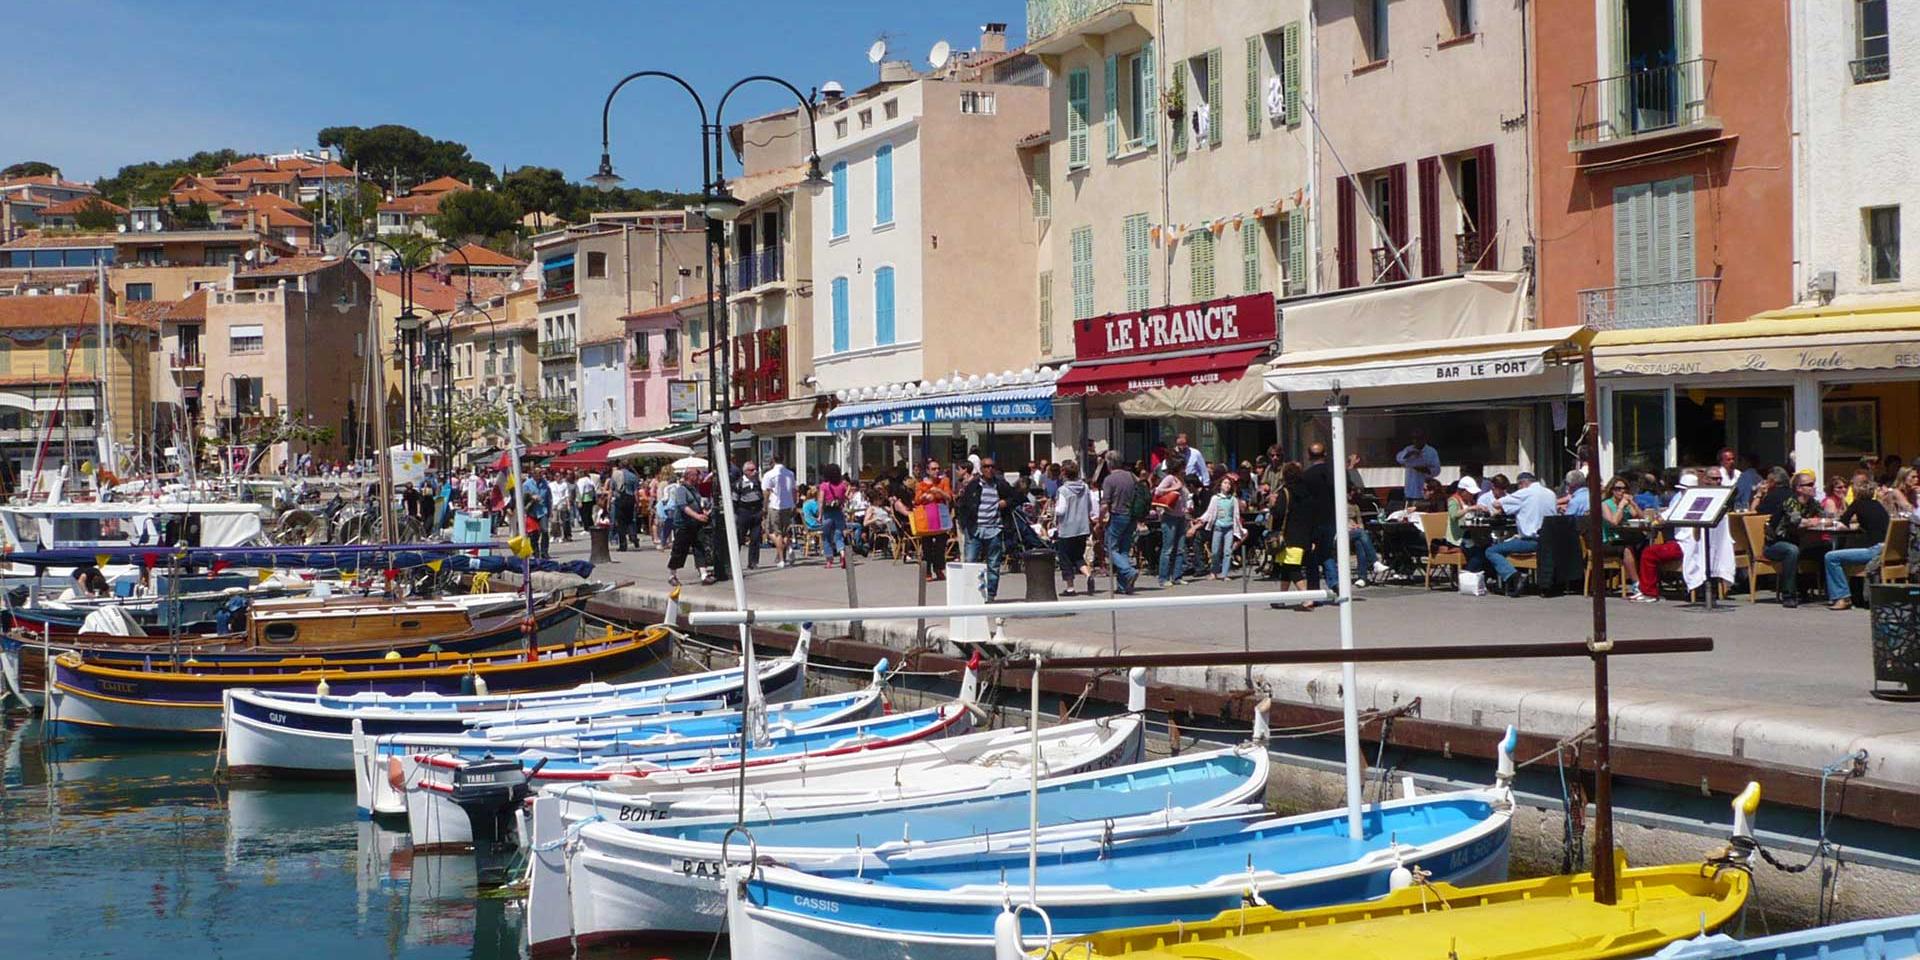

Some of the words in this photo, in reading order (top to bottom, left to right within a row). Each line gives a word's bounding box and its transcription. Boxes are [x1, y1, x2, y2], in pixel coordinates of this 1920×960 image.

[1105, 318, 1134, 352] LE
[1139, 304, 1239, 348] FRANCE
[1436, 367, 1459, 378] BAR
[1470, 365, 1484, 376] LE
[1495, 361, 1527, 374] PORT
[1625, 362, 1701, 373] RESTAURANT
[1741, 353, 1766, 368] La
[1086, 384, 1098, 393] BAR
[1128, 378, 1165, 389] BRASSERIE
[1191, 373, 1219, 383] GLACIER
[864, 413, 884, 428] BAR
[890, 411, 904, 424] DE
[911, 408, 925, 421] LA
[935, 404, 983, 420] MARINE
[269, 712, 287, 724] GUY
[466, 773, 496, 783] YAMAHA
[793, 895, 840, 913] CASSIS
